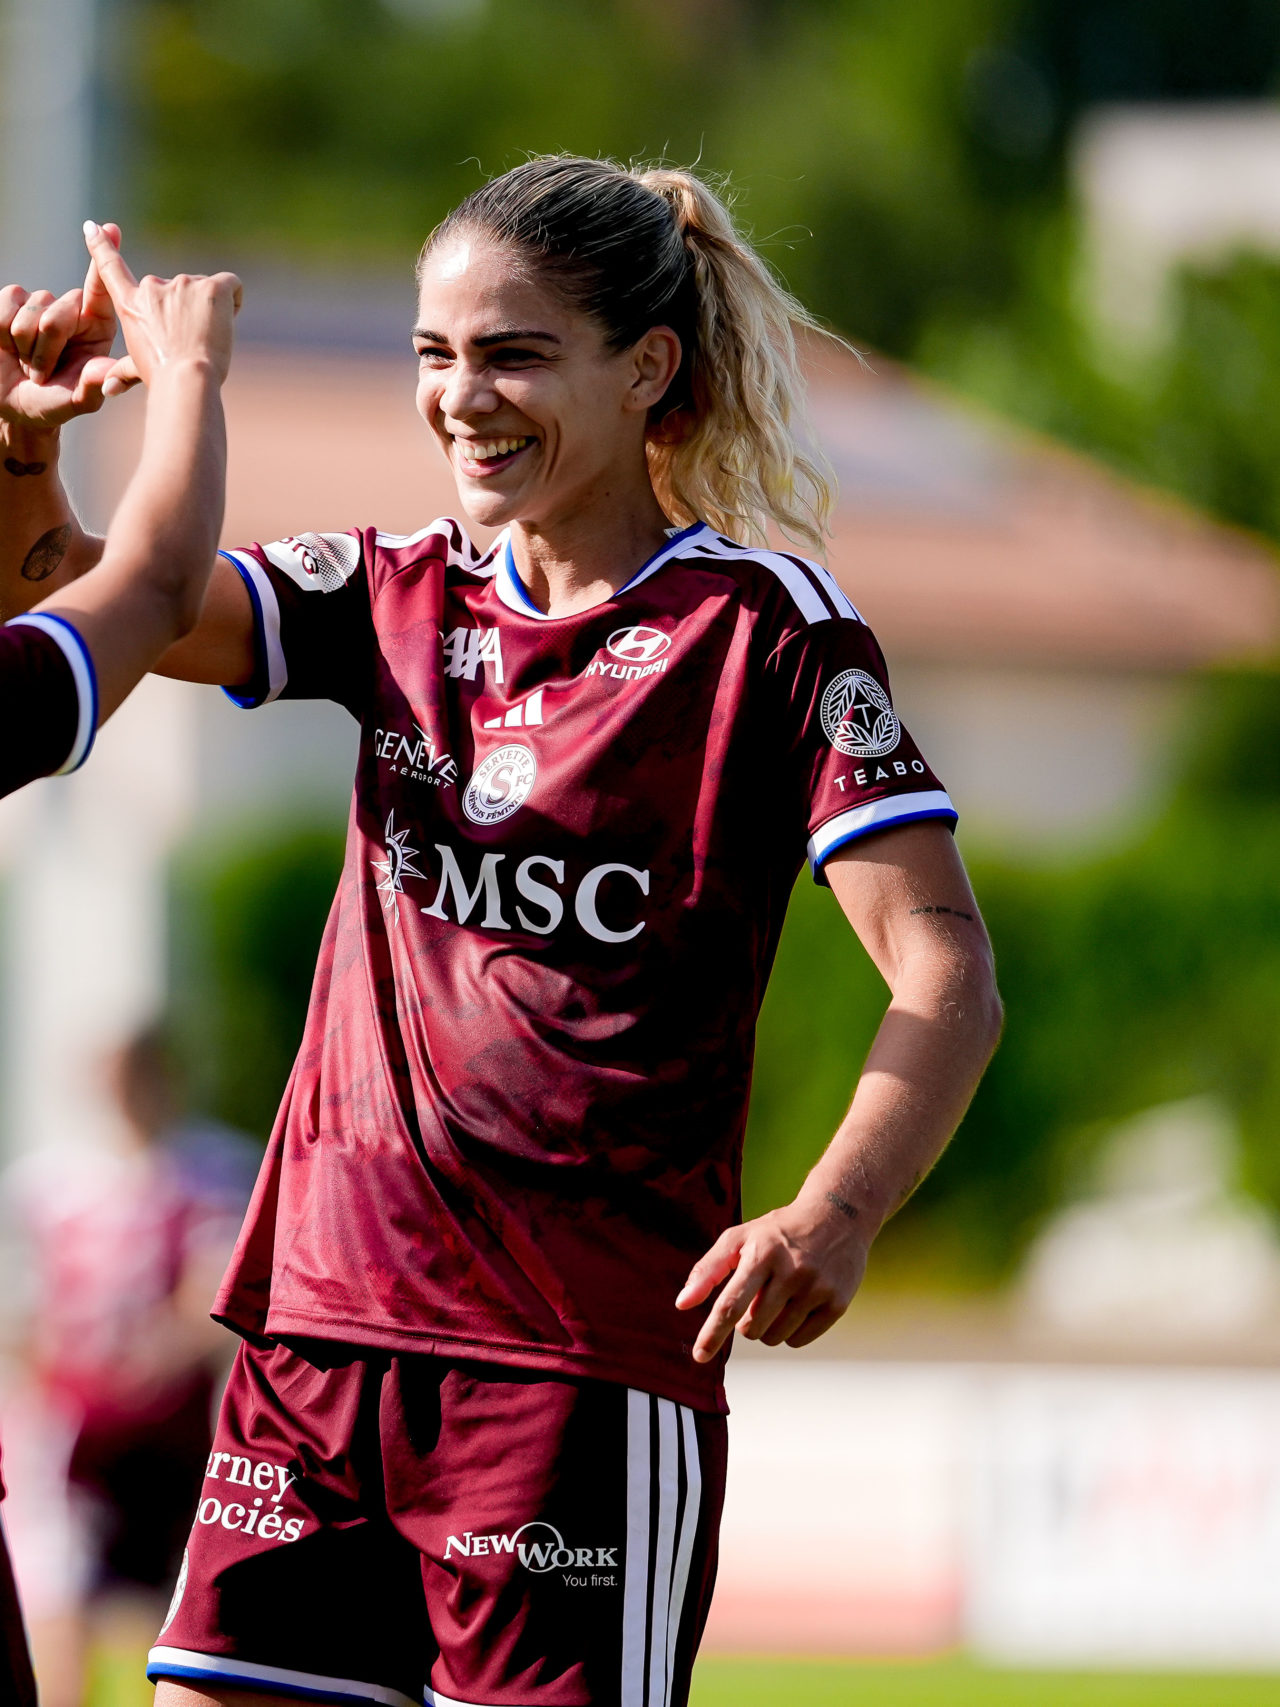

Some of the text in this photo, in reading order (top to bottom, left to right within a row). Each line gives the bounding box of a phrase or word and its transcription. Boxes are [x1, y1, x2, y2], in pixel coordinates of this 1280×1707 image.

[584, 658, 669, 681] HYUNDAI
[853, 703, 871, 728] T
[389, 764, 450, 789] AÉROPORT
[479, 750, 531, 779] SERVETTE
[834, 760, 925, 792] TEABO
[485, 764, 515, 805] S
[515, 772, 534, 788] FC
[468, 785, 486, 819] CHÊNOIS
[421, 843, 650, 943] MSC
[205, 1451, 299, 1503] rney
[193, 1497, 305, 1543] ociés
[562, 1574, 618, 1587] You first.
